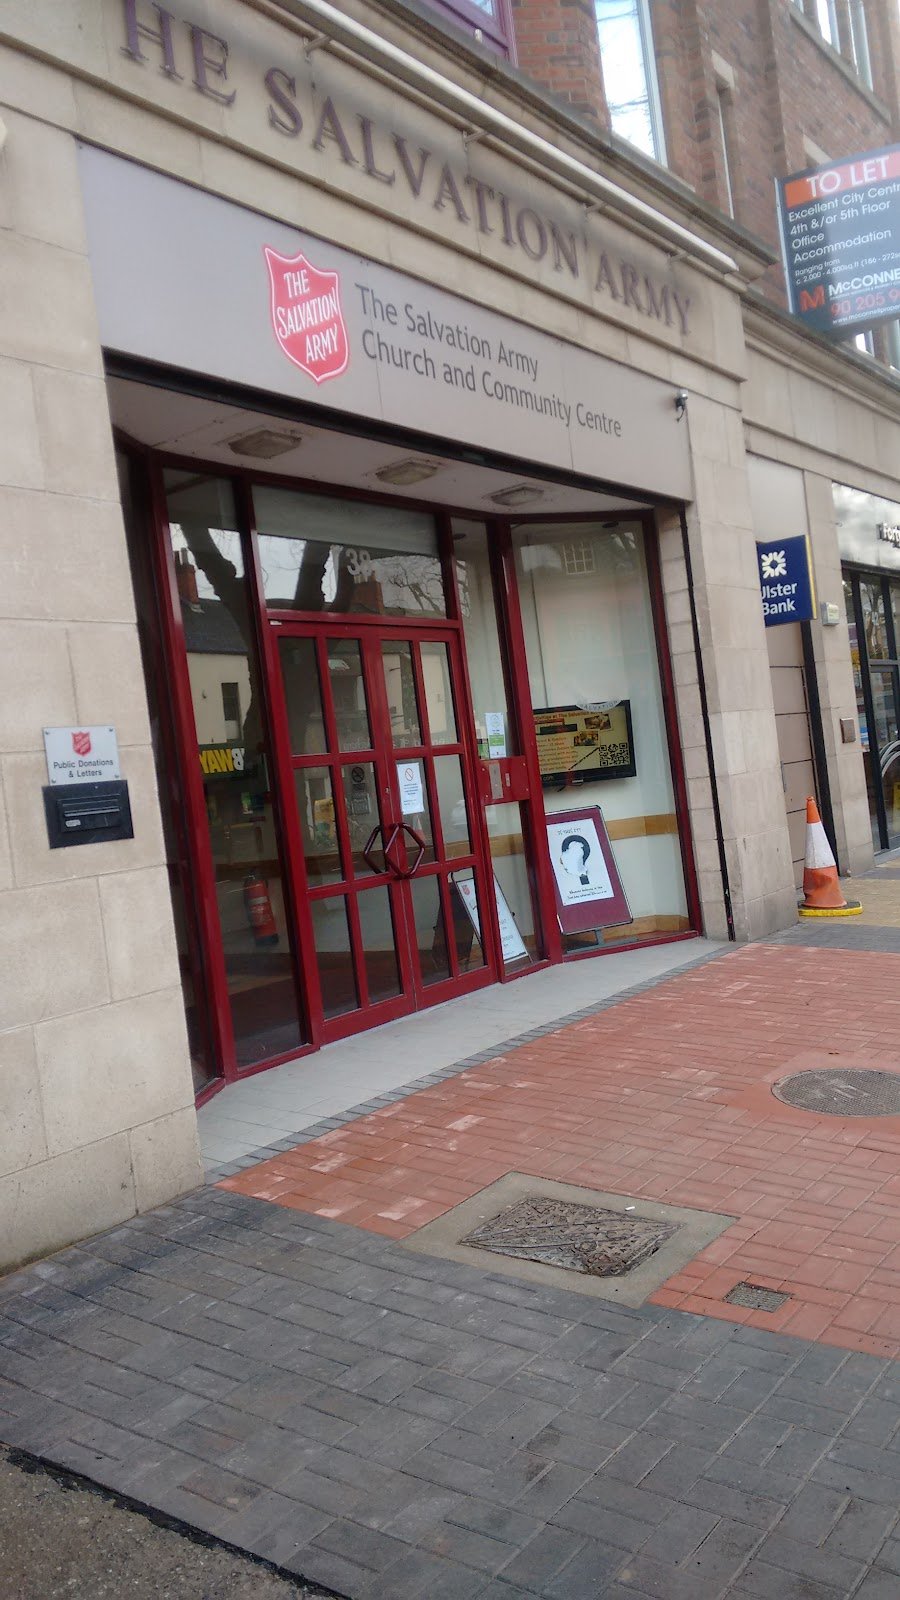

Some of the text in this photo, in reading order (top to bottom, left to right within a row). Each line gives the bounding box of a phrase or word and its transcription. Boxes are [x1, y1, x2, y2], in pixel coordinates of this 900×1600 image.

[120, 0, 692, 336] HE SALVATION ARMY
[806, 155, 890, 197] TO LET
[788, 197, 839, 222] Excellent
[842, 192, 865, 205] City
[790, 222, 808, 235] 4th
[840, 207, 859, 221] 5th
[862, 200, 891, 215] Floor
[792, 233, 825, 249] Office
[794, 229, 892, 263] Accommodation
[283, 269, 310, 299] THE
[856, 291, 886, 311] 205
[889, 287, 900, 302] 9
[276, 287, 339, 339] SALVATION
[305, 322, 338, 364] ARMY
[354, 282, 539, 382] The Salvation Army
[361, 329, 623, 438] Church and Community Centre
[762, 598, 796, 616] Bank
[53, 758, 114, 769] Public Donations
[76, 769, 103, 778] Letters
